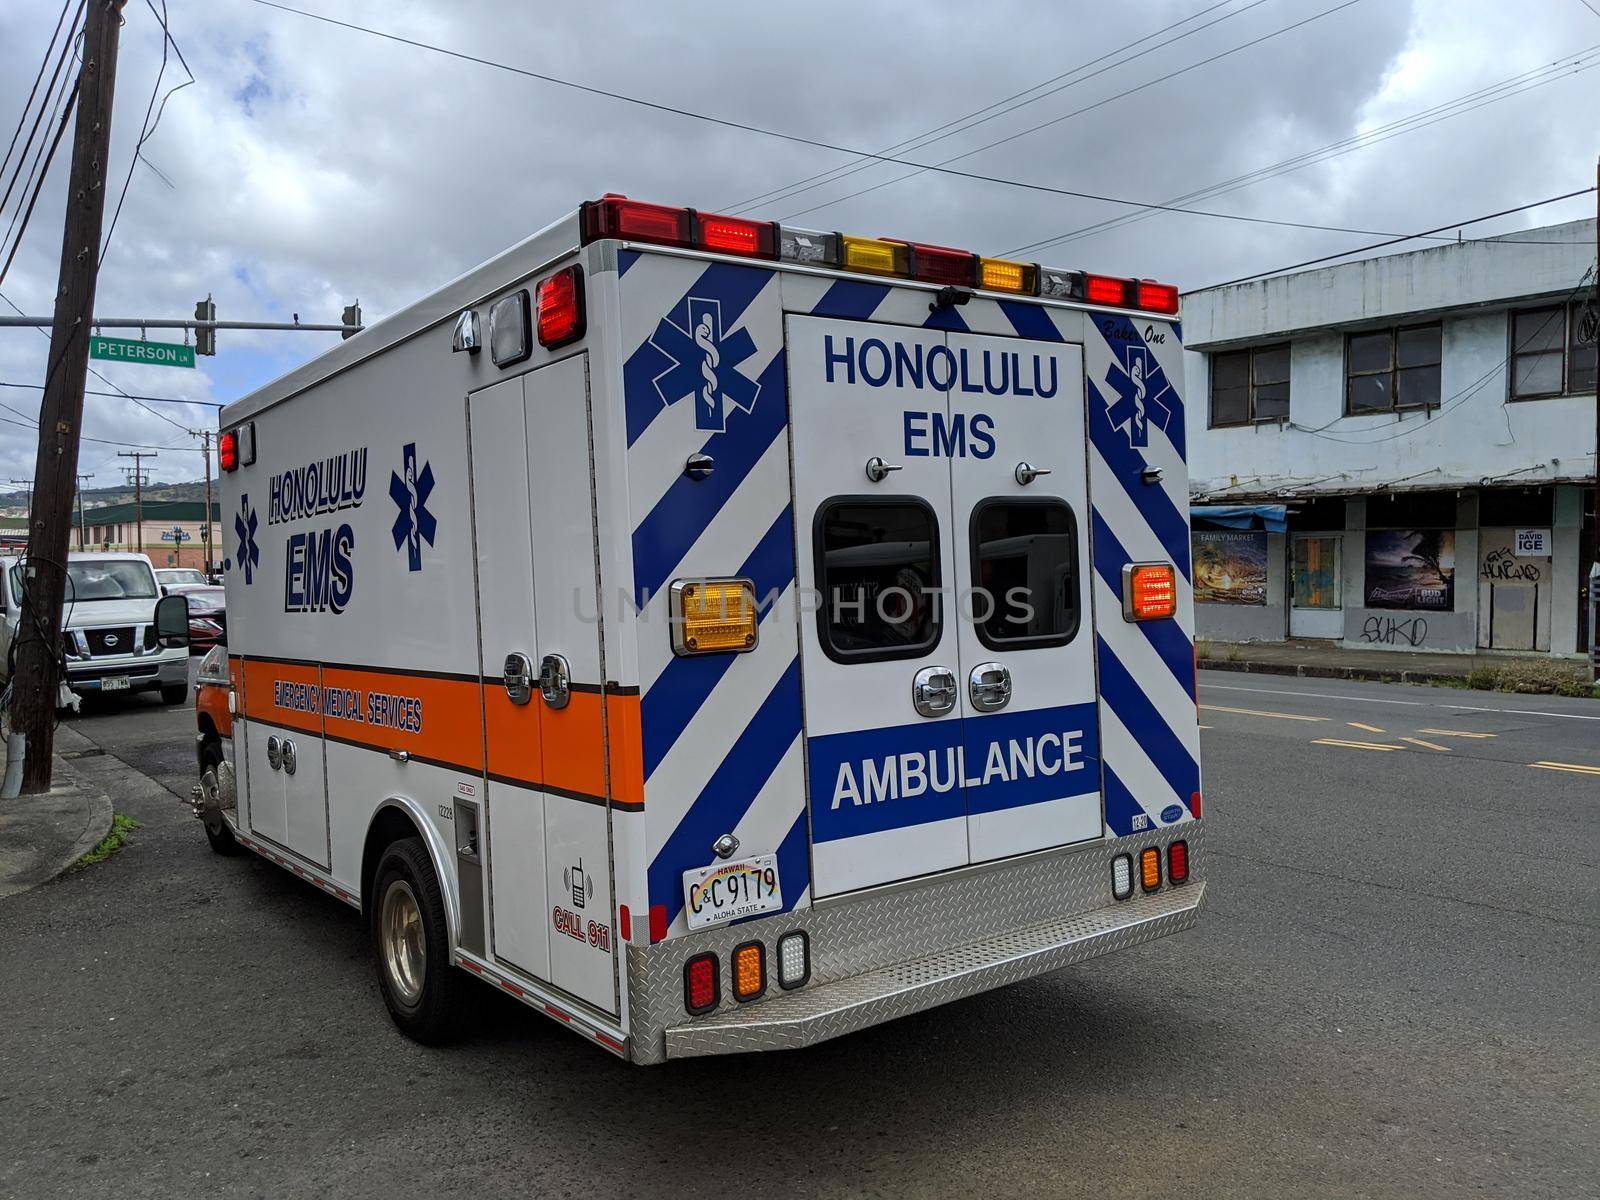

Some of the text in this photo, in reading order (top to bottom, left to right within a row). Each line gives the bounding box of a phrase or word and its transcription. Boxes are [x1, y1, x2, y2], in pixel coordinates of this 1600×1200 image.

[1144, 325, 1166, 344] One
[97, 342, 177, 361] PETERSON
[824, 335, 1058, 399] HONOLULU
[903, 411, 996, 460] EMS
[268, 447, 368, 526] HONOLULU
[1200, 534, 1255, 542] FAMILY MARKET
[1518, 540, 1543, 551] IGE
[284, 523, 355, 615] EMS
[1417, 596, 1445, 604] LIGHT
[1421, 589, 1441, 597] BUD
[274, 680, 423, 734] EMERGENCY MEDICAL SERVICES
[831, 730, 1085, 810] AMBULANCE
[717, 863, 745, 876] HAWAII
[713, 904, 759, 921] ALOHA STATE
[553, 905, 611, 953] CALL 911
